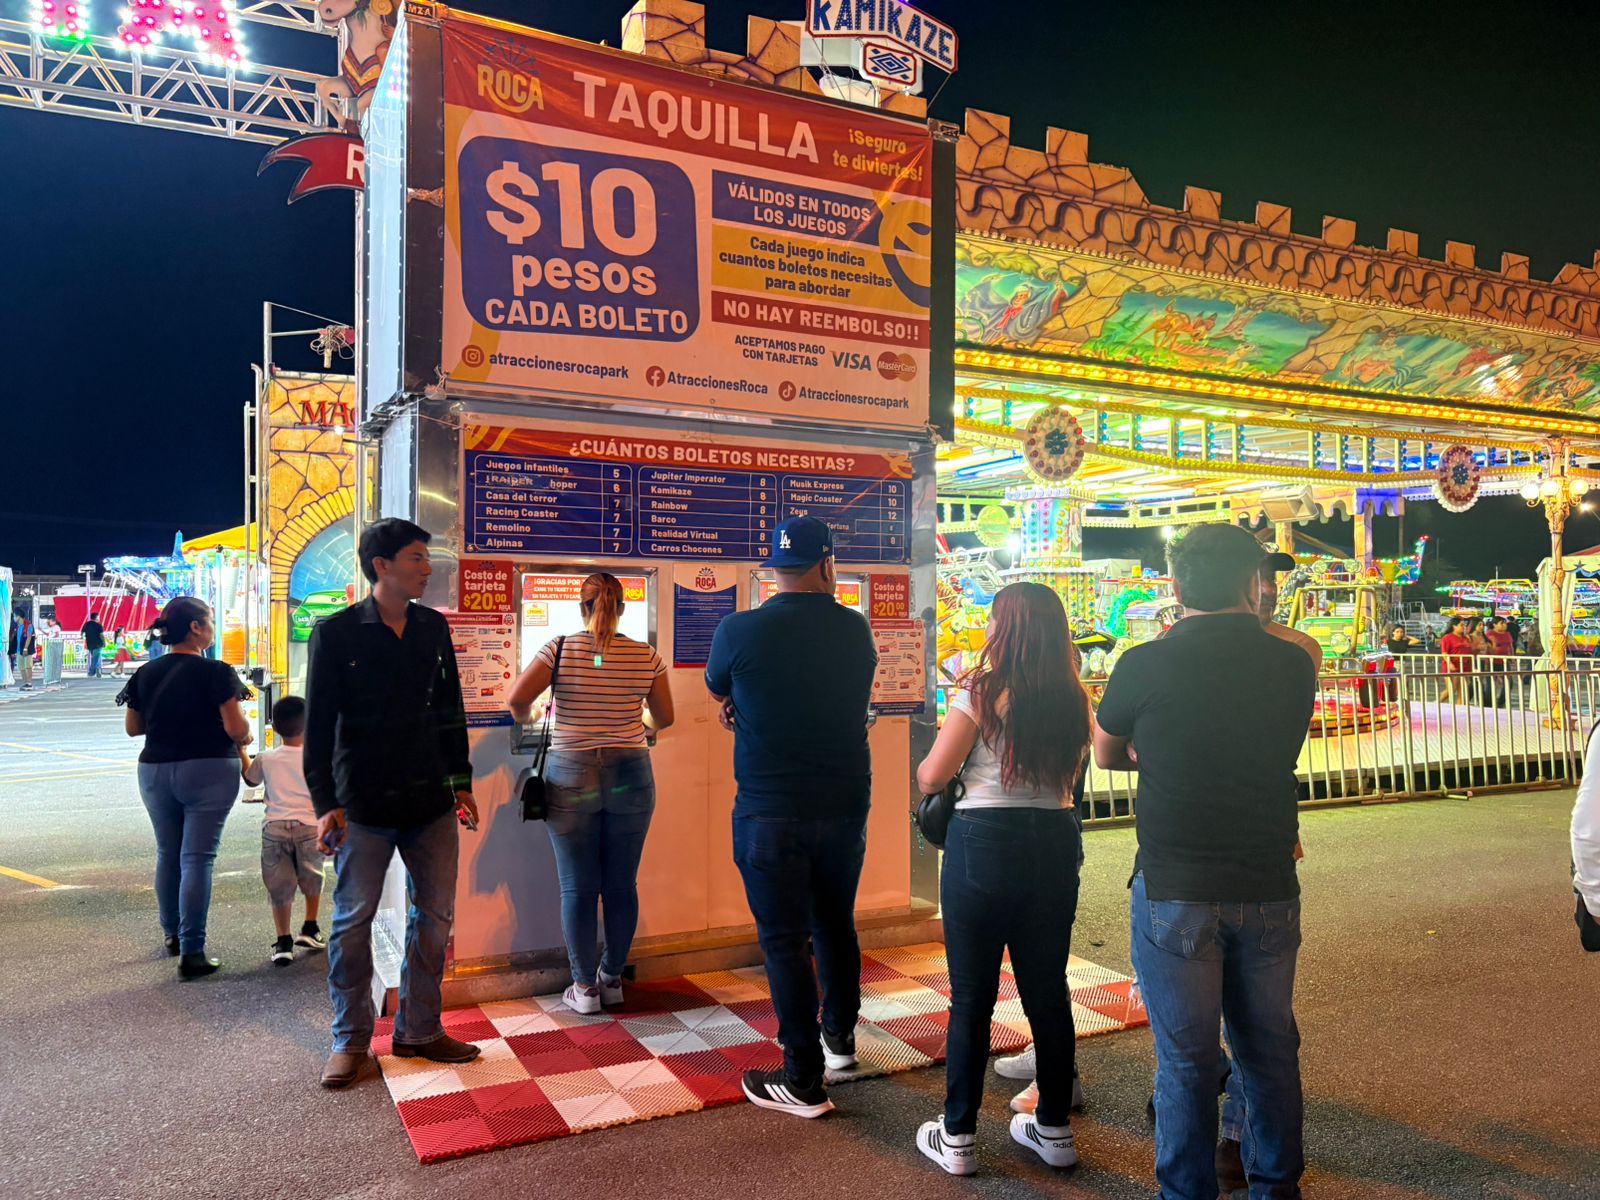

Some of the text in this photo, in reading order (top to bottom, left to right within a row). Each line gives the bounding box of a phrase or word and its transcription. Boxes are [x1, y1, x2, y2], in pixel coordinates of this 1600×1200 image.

[813, 0, 953, 66] KAMIKAZE
[477, 63, 545, 114] ROCA
[573, 71, 819, 164] TAQUILLA
[849, 129, 907, 154] ¡Seguro
[833, 150, 923, 181] te diviertes!
[486, 160, 657, 256] $10
[728, 181, 871, 222] VÁLIDOS EN TODOS
[754, 206, 847, 235] LOS JUEGOS
[750, 236, 865, 267] Cada juego indica
[511, 254, 657, 297] pesos
[719, 251, 893, 288] cuantos boletos necesitas
[765, 276, 851, 298] para abordar
[485, 298, 689, 335] CADA BOLETO
[723, 299, 919, 341] NO HAY REEMBOLSO!!
[735, 335, 826, 355] ACEPTAMOS PAGO
[489, 352, 629, 380] atraccionesrocapark
[742, 349, 818, 367] CON TARJETAS
[830, 350, 872, 371] VISA
[878, 360, 917, 373] MasterCard
[667, 371, 768, 395] AtraccionesRoca
[799, 386, 909, 409] Atraccionesrocapark
[569, 438, 855, 472] ¿CUÁNTOS BOLETOS NECESITAS?
[486, 460, 620, 478] Juegos infantiles 5
[651, 471, 682, 481] Jupiter
[684, 473, 726, 484] Imperator
[651, 486, 692, 496] Kamikaze
[790, 480, 897, 494] Musik Express 10
[486, 491, 620, 508] Casa del terror 7
[651, 501, 688, 510] Rainbow
[790, 493, 897, 507] Magic Coaster 10
[486, 507, 620, 523] Racing Coaster 7
[651, 515, 677, 524] Barco
[790, 507, 897, 520] Zeus 12
[486, 523, 620, 538] Remolino 7
[651, 529, 688, 538] Realidad
[690, 530, 718, 540] Virtual
[779, 530, 791, 548] LA
[486, 538, 620, 552] Alpinas 7
[651, 543, 768, 556] Carros Chocones 10
[464, 569, 507, 581] Costo de
[696, 577, 716, 591] ROCA
[465, 581, 506, 593] tarjeta
[873, 582, 905, 592] Costo de
[874, 592, 904, 602] tarjeta
